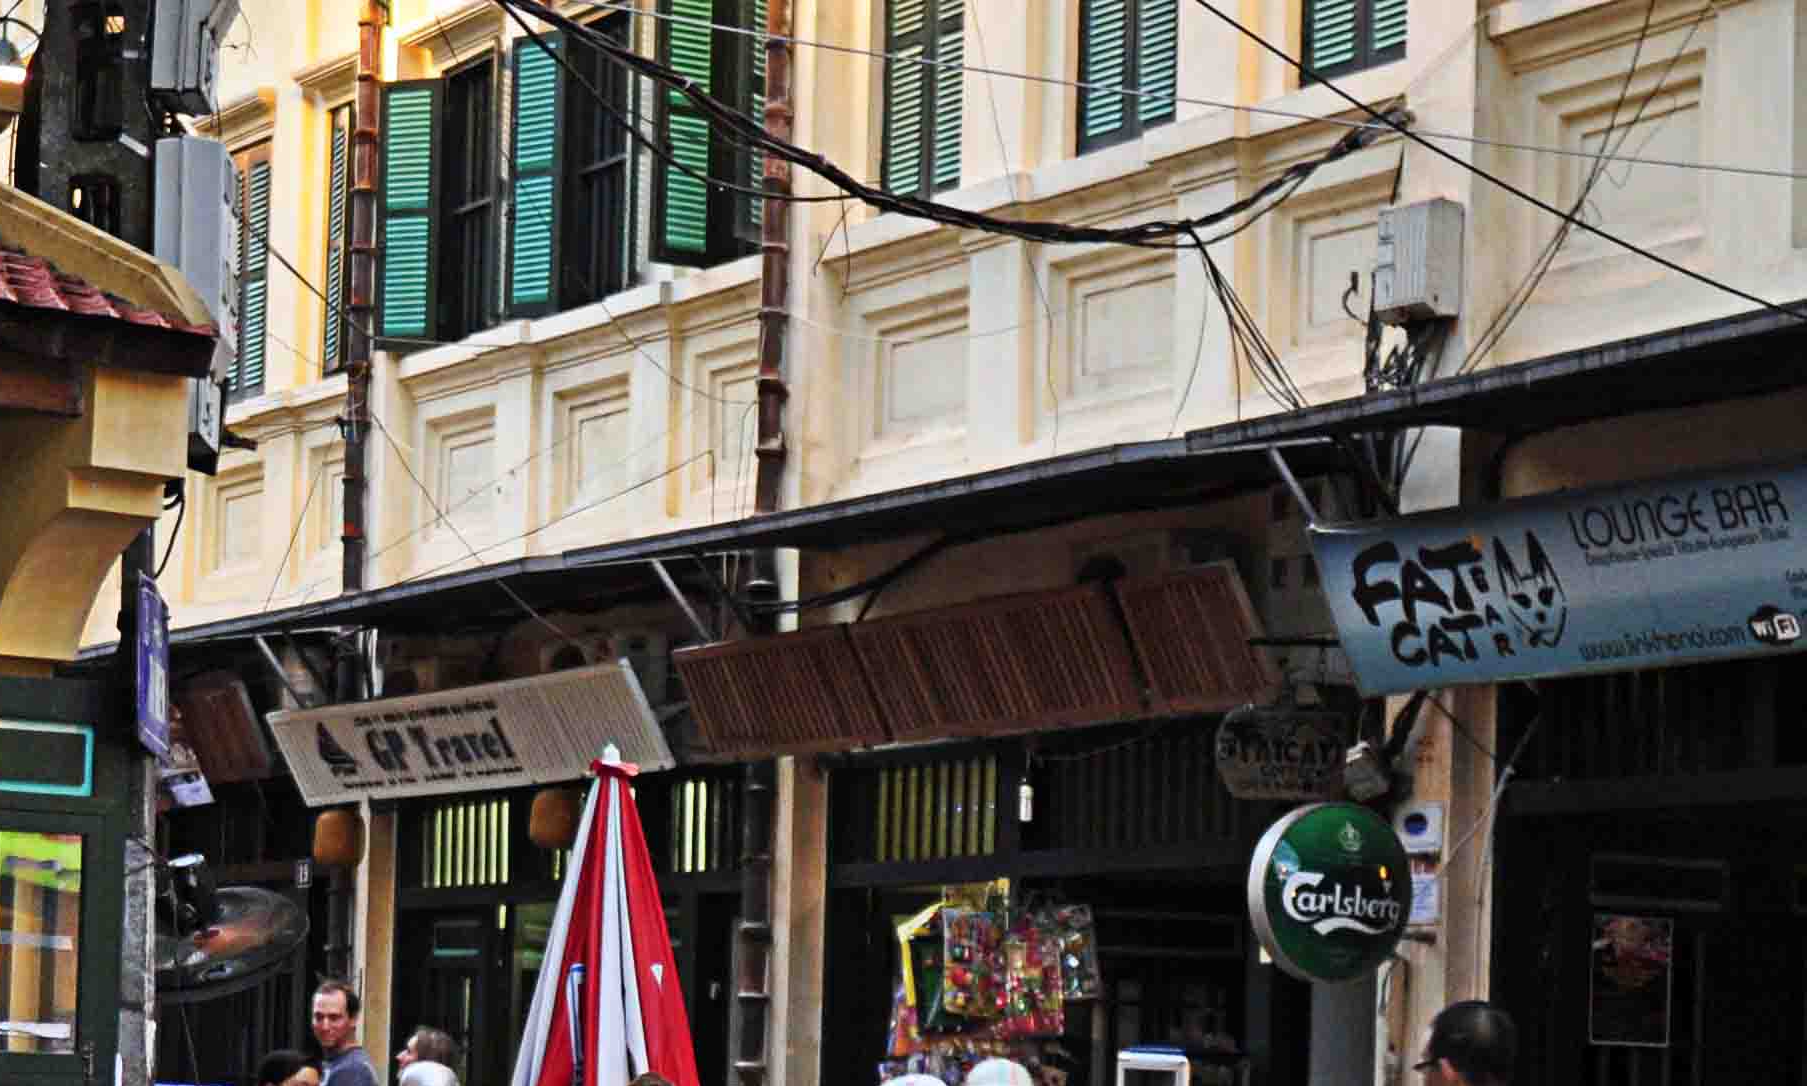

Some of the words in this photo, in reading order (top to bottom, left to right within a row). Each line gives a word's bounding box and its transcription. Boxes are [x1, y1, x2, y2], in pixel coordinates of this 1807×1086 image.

[1712, 480, 1790, 530] BAR
[1352, 538, 1483, 627] FAT
[1391, 613, 1484, 668] CAT
[1283, 871, 1401, 927] Carlsberg
